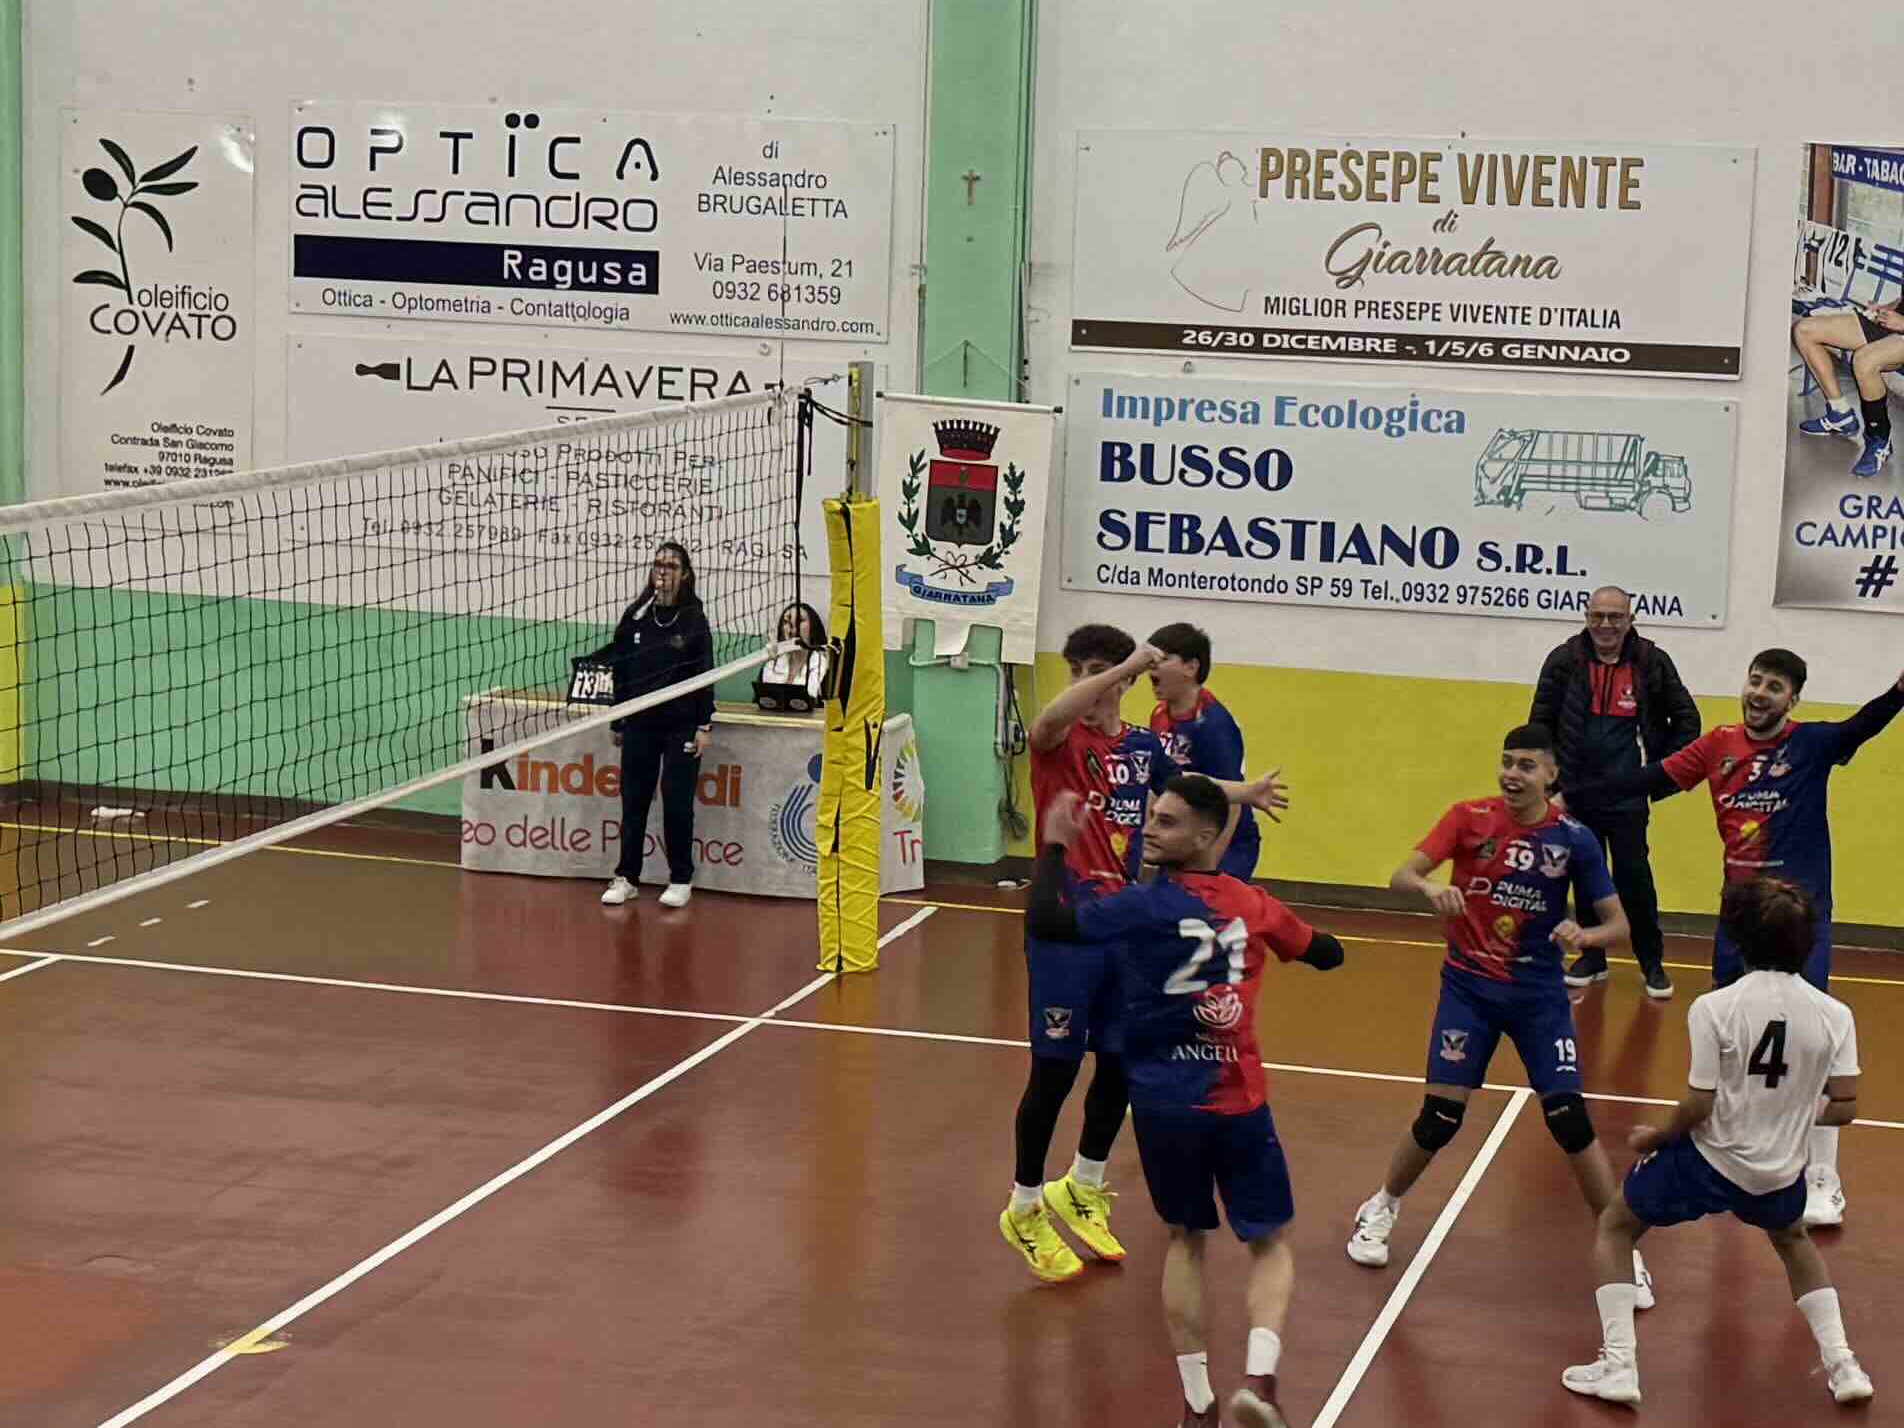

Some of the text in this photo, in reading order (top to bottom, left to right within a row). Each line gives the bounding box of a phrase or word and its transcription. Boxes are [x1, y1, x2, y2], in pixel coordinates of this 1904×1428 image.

[762, 141, 779, 161] di
[712, 166, 828, 190] Alessandro
[1256, 146, 1645, 210] PRESEPE VIVENTE
[697, 194, 849, 220] BRUGALETTA
[1432, 210, 1460, 235] di
[503, 250, 648, 290] Ragusa
[694, 252, 726, 275] Via
[832, 259, 854, 279] 21
[1322, 221, 1563, 289] Giarratana
[137, 284, 229, 312] oleificio
[321, 288, 631, 324] Ottica Optometria Contattologia
[711, 281, 841, 306] 0932 681359
[89, 304, 237, 342] COVATO
[1264, 295, 1621, 329] MIGLIOR PRESEPE VIVENTE D'ITALIA
[1181, 328, 1631, 364] 26/30 DICEMBRE 1/5/6 GENNAIO
[1100, 387, 1466, 439] Impresa Ecologica
[111, 434, 160, 446] Contrada
[163, 437, 183, 448] San
[196, 425, 234, 437] Covato
[159, 451, 234, 466] 97010 Ragusa
[1099, 440, 1293, 492] BUSSO
[1096, 508, 1588, 578] SEBASTIANO S.R.L.
[913, 584, 995, 604] GIARRATANA
[1096, 563, 1530, 609] C/da Monterotondo SP 59 Tel. 0932 975266
[505, 813, 593, 852] delle
[1504, 847, 1534, 871] 19
[1163, 917, 1248, 994] 21
[1554, 1038, 1577, 1063] 19
[1747, 1019, 1788, 1089] 4
